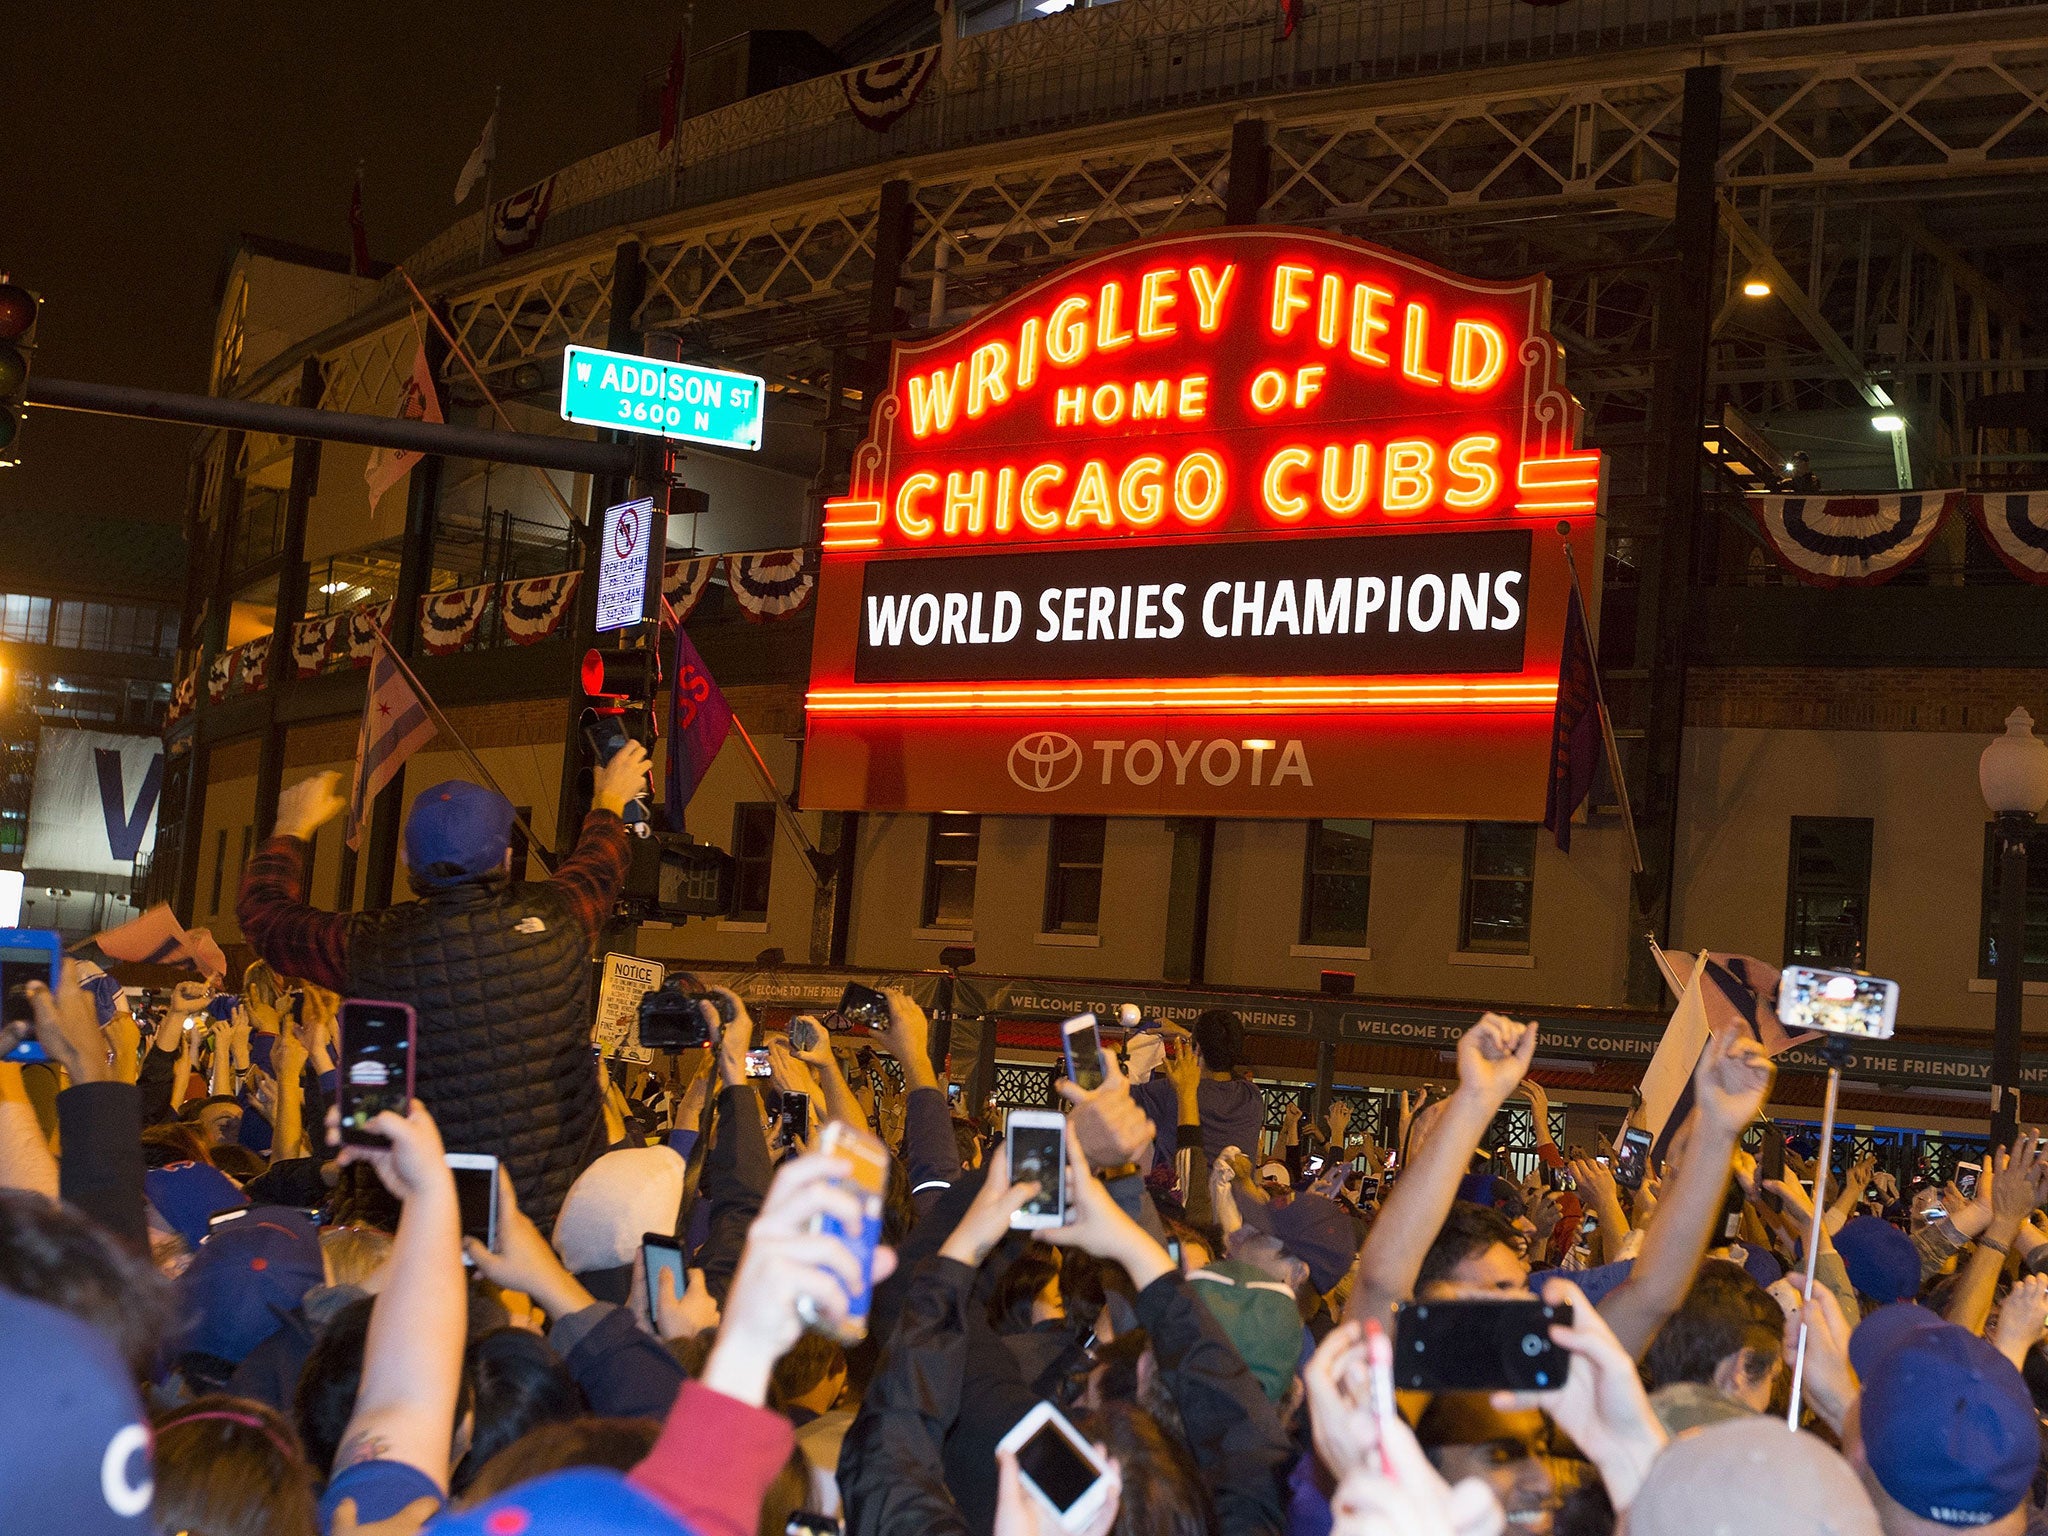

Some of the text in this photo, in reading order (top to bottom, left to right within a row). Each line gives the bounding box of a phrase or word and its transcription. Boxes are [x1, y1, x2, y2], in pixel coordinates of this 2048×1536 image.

[908, 264, 1505, 437] WRIGLEY FIELD
[576, 362, 752, 409] W ADDISON ST
[1056, 366, 1326, 427] HOME OF
[618, 399, 709, 431] 3600 N
[895, 436, 1498, 536] CHICAGO CUBS
[867, 570, 1523, 647] WORLD SERIES CHAMPIONS
[1093, 739, 1314, 787] TOYOTA
[615, 963, 652, 981] NOTICE
[749, 984, 845, 997] WELCOME TO THE FRIEN
[1010, 995, 1082, 1012] WELCOME
[1087, 1001, 1106, 1014] TO
[1143, 1005, 1203, 1020] FRIEND
[1357, 1020, 1463, 1039] WELCOME TO
[1587, 1037, 1660, 1053] CONFIN
[1863, 1056, 1898, 1071] THE
[1902, 1059, 1991, 1078] FRIENDLY
